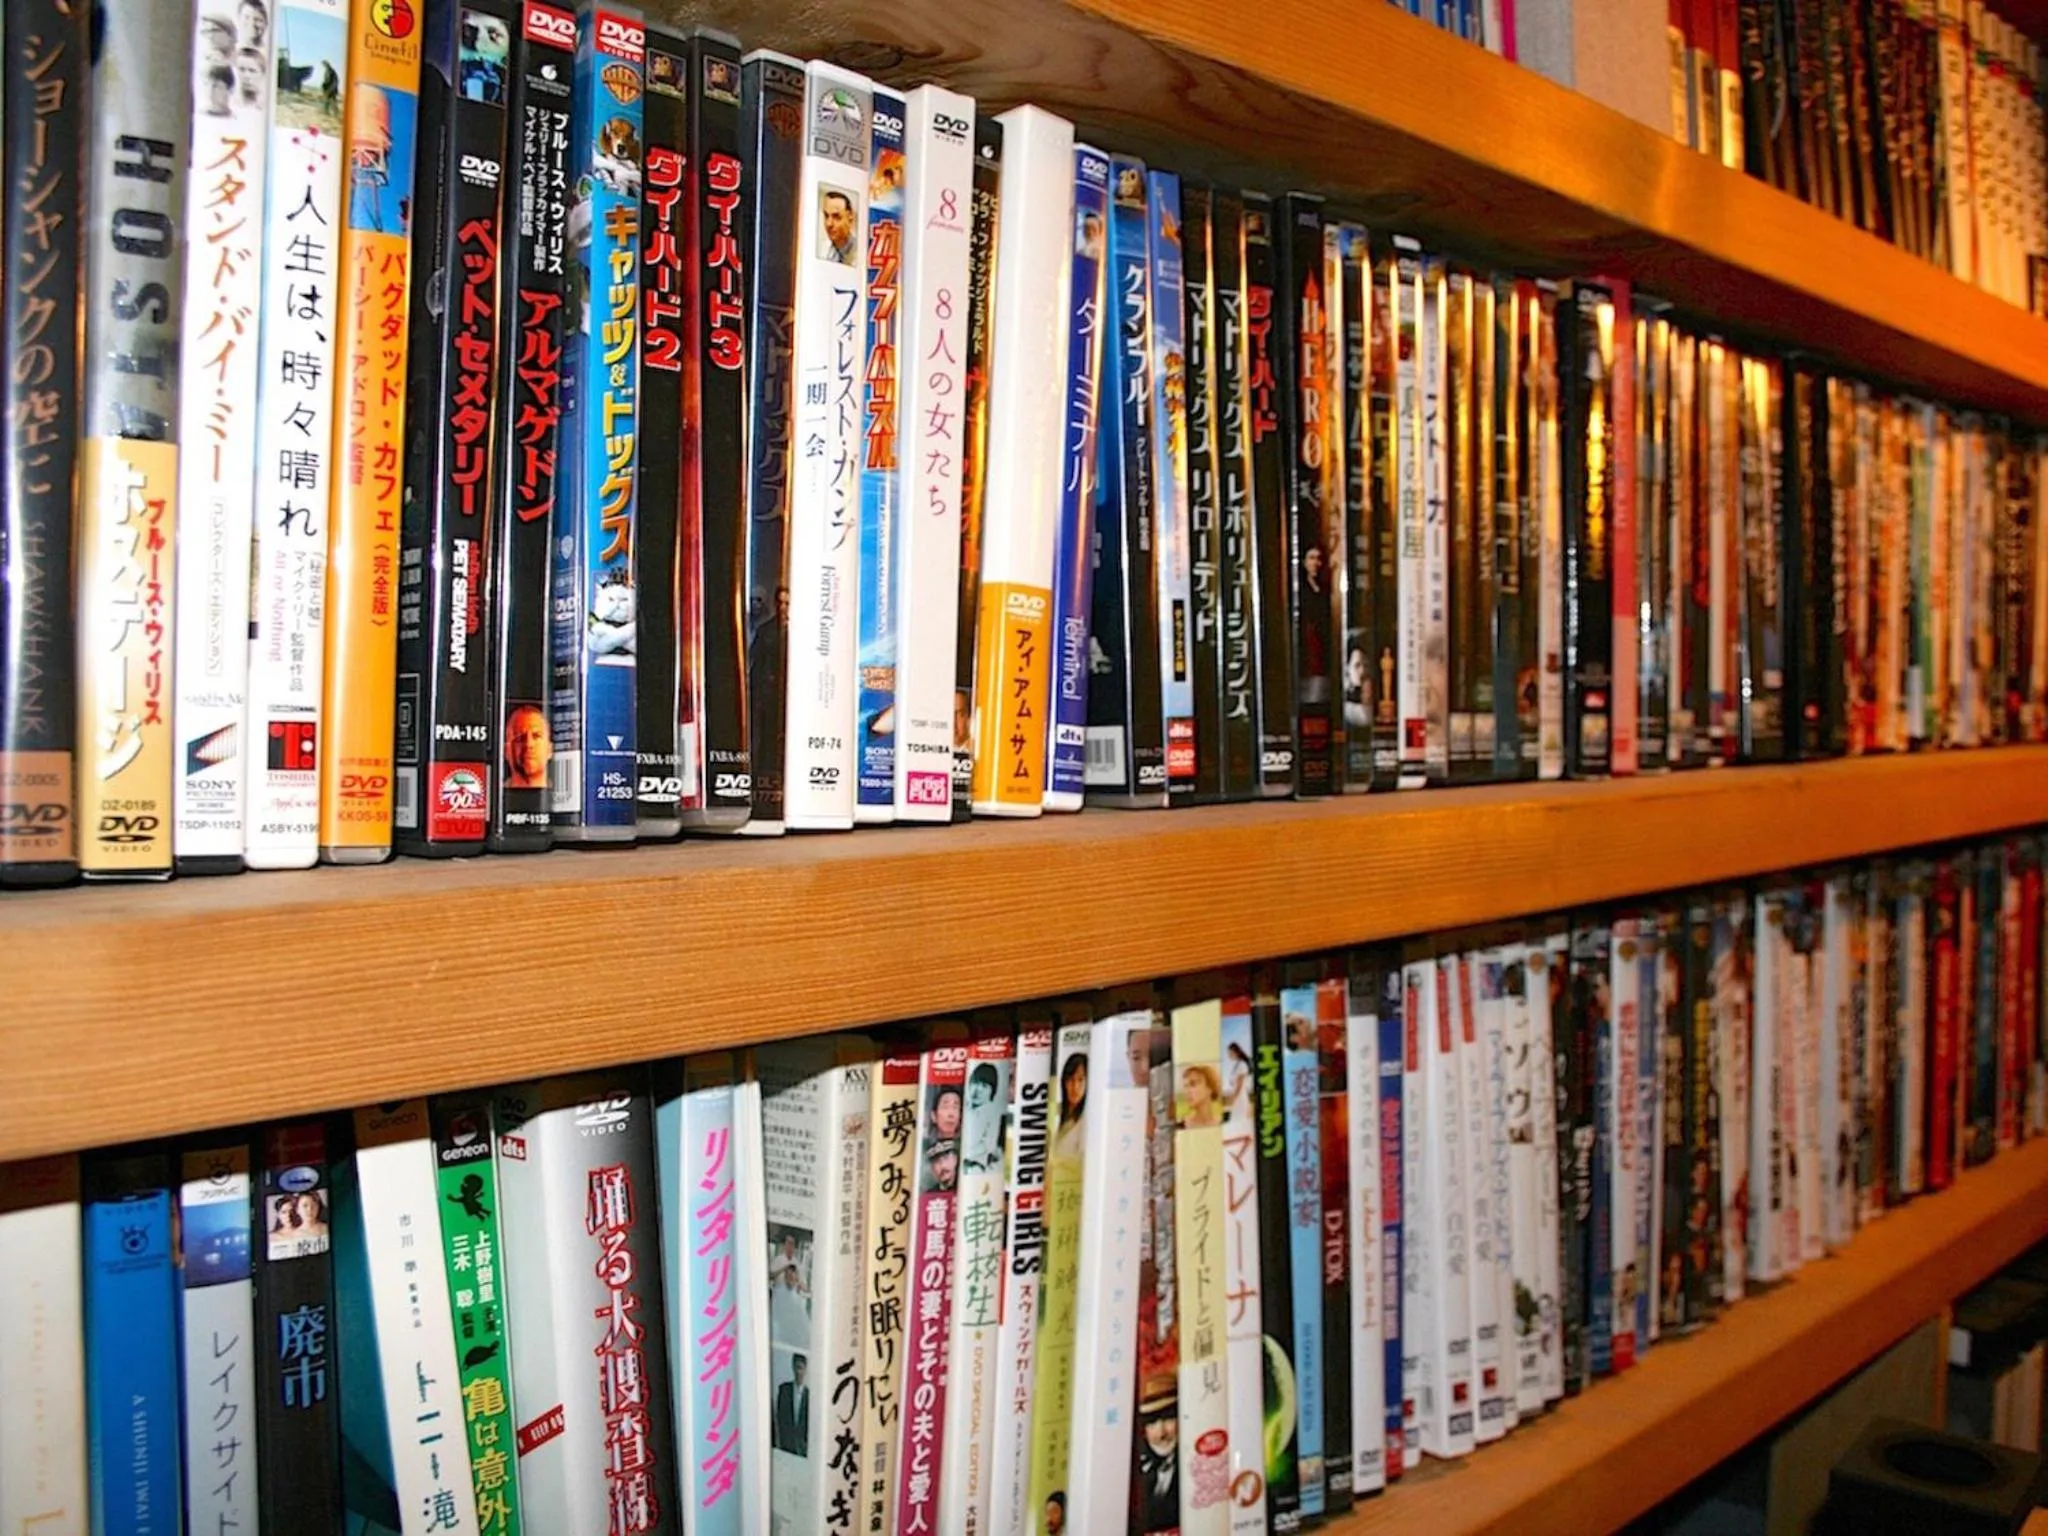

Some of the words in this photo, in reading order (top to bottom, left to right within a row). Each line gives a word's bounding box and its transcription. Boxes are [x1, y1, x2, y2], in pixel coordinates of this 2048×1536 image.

[529, 12, 576, 35] DVD
[600, 18, 645, 43] DVD
[873, 112, 903, 131] DVD
[934, 113, 969, 132] DVD
[460, 154, 499, 174] DVD
[814, 137, 864, 164] DVD
[549, 112, 570, 276] ブルース・ウィリス
[197, 136, 253, 483] スタンド・バイ・ミー
[279, 184, 328, 537] 人生は、時々晴れ
[451, 219, 499, 515] ペット・セメタリー
[1302, 297, 1324, 470] HERO
[515, 288, 563, 524] アルマゲドン
[804, 363, 829, 460] 一期一会
[926, 288, 957, 517] 8人の女たち
[451, 539, 469, 575] PET
[145, 500, 167, 726] ブルース・ウィリス
[1008, 593, 1045, 609] DVD
[22, 521, 51, 736] SHAWSHANK
[449, 578, 468, 674] SEMATARY
[1062, 616, 1083, 700] Terminal
[1011, 629, 1033, 780] アイ・アム・サム
[436, 723, 488, 742] PDA-145
[808, 737, 842, 750] PDF-74
[907, 743, 949, 753] TOSHIBA
[1062, 730, 1082, 741] dts
[809, 767, 840, 778] DVD
[1262, 751, 1292, 764] DVD
[186, 780, 236, 790] SONY
[340, 776, 388, 791] DVD
[597, 786, 634, 801] 21253
[603, 773, 627, 786] HS-
[638, 777, 683, 793] DVD
[715, 775, 751, 789] DVD
[0, 804, 68, 822] DVD
[98, 816, 160, 832] DVD
[933, 1048, 968, 1061] DVD
[1258, 1044, 1284, 1160] エイリアン
[579, 1121, 628, 1138] VIDEO
[1017, 1082, 1050, 1185] SWING
[502, 1139, 526, 1160] dts
[1012, 1190, 1044, 1276] GIRLS
[1222, 1134, 1258, 1327] マレーナ
[451, 1234, 472, 1273] 三木
[865, 1098, 917, 1427] 夢みるように眠りたい
[961, 1200, 1005, 1327] 転校生
[278, 1303, 328, 1411] 廃市
[585, 1160, 660, 1536] 踊る大捜査線
[905, 1198, 949, 1535] 竜馬の妻とその夫と愛人
[209, 1330, 243, 1536] レイクサイド
